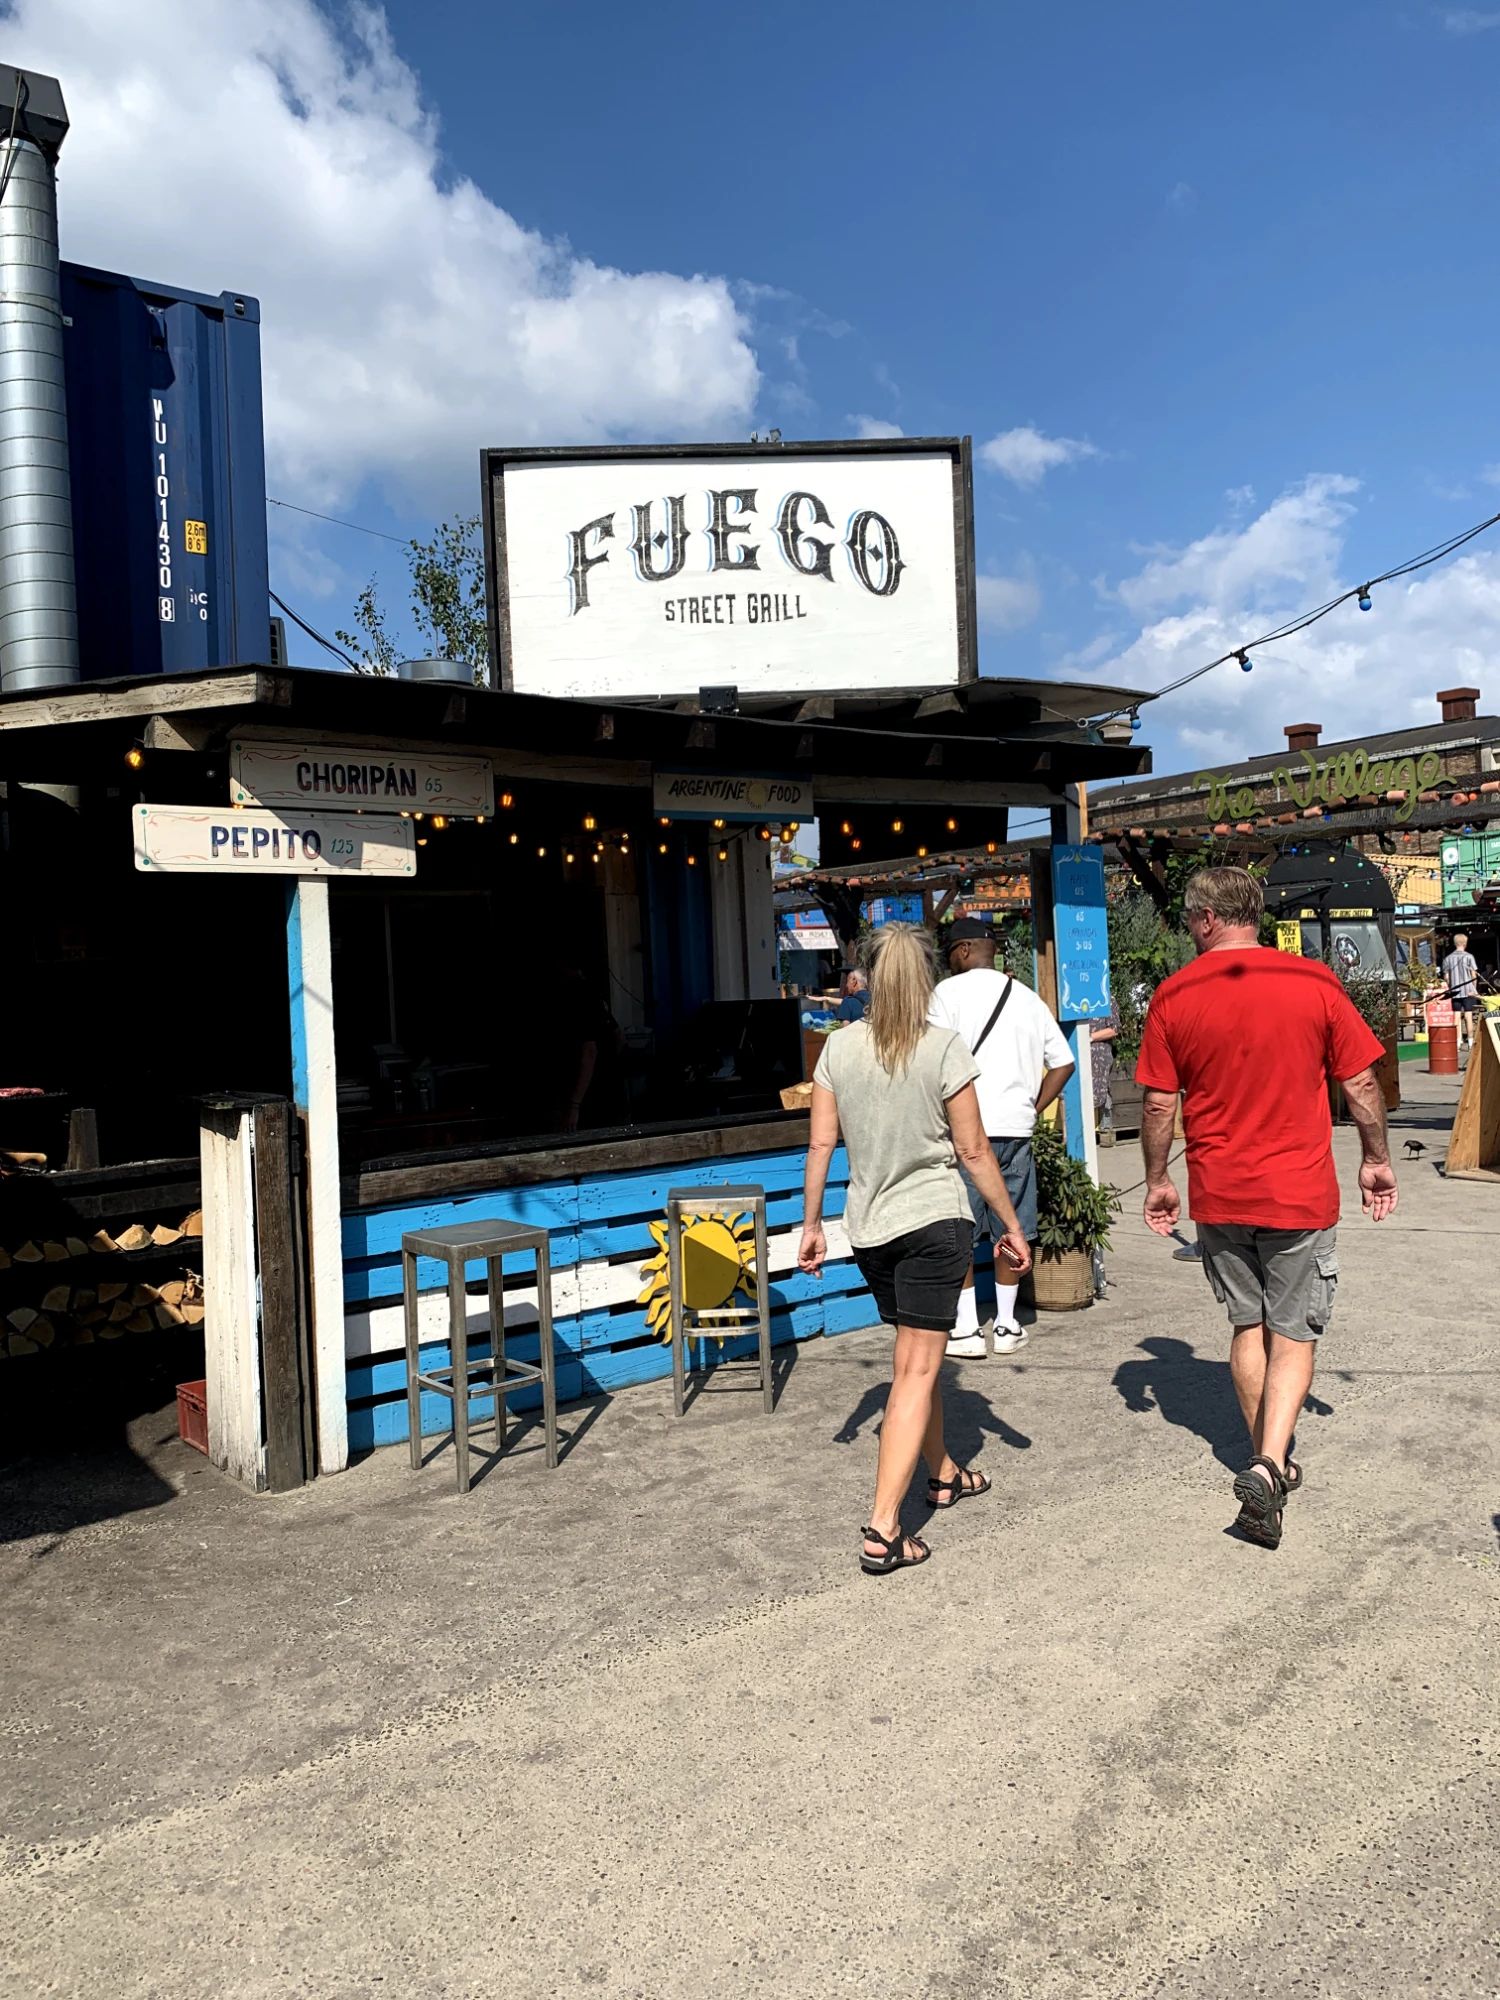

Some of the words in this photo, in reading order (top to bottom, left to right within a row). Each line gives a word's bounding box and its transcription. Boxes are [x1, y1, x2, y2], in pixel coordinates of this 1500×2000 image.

[564, 488, 907, 617] FUEGO
[665, 595, 735, 625] STREET
[747, 592, 807, 624] GRILL
[296, 761, 417, 797] CHORIPÁN
[424, 777, 443, 794] 65
[668, 779, 747, 801] ARGENTINE
[767, 784, 801, 804] FOOD
[1193, 772, 1265, 821] The
[1273, 748, 1457, 822] Village
[210, 825, 322, 861] PEPITO
[330, 838, 355, 855] 125
[1076, 911, 1084, 922] 65
[1284, 937, 1296, 945] FAT
